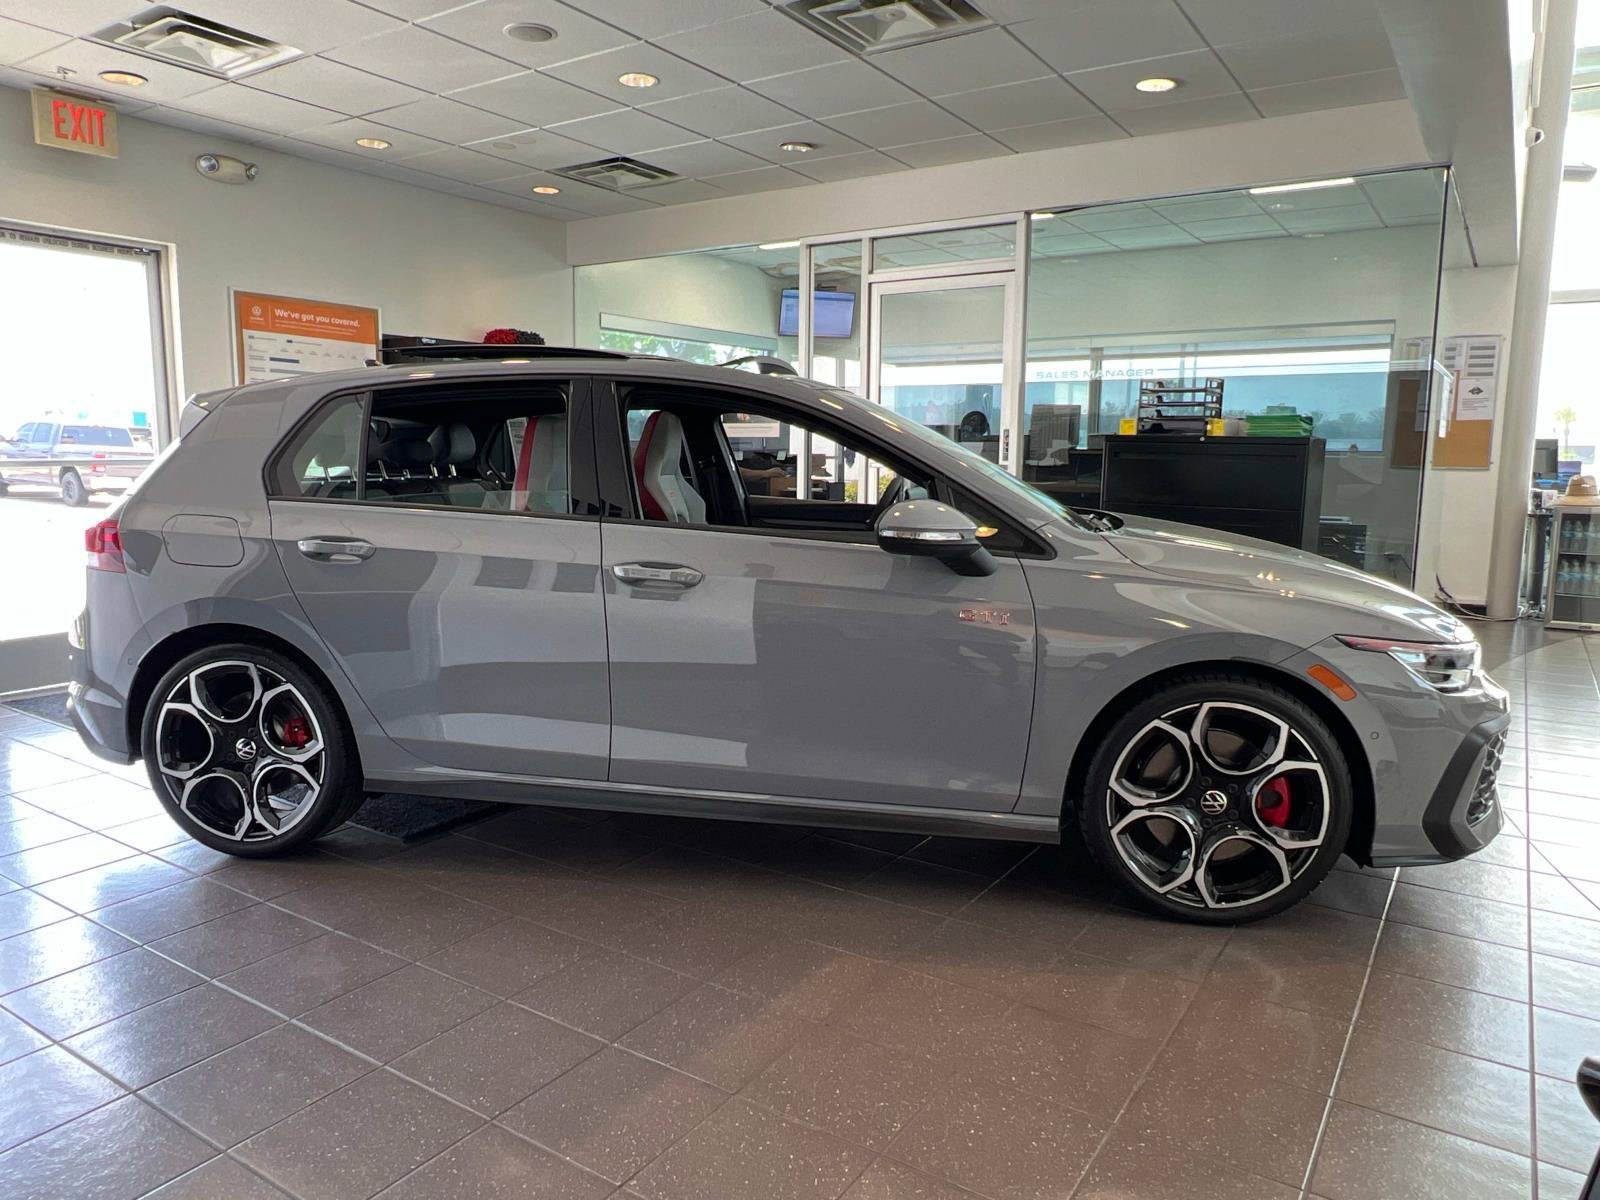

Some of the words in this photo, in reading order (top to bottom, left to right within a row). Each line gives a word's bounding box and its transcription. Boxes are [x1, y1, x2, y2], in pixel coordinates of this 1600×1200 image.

[51, 100, 106, 147] EXIT
[9, 232, 16, 240] TO
[274, 308, 300, 319] We've
[301, 312, 314, 322] got
[315, 315, 330, 324] you
[1036, 370, 1079, 379] SALES
[1084, 368, 1154, 379] MANAGER
[959, 607, 1010, 625] GTI
